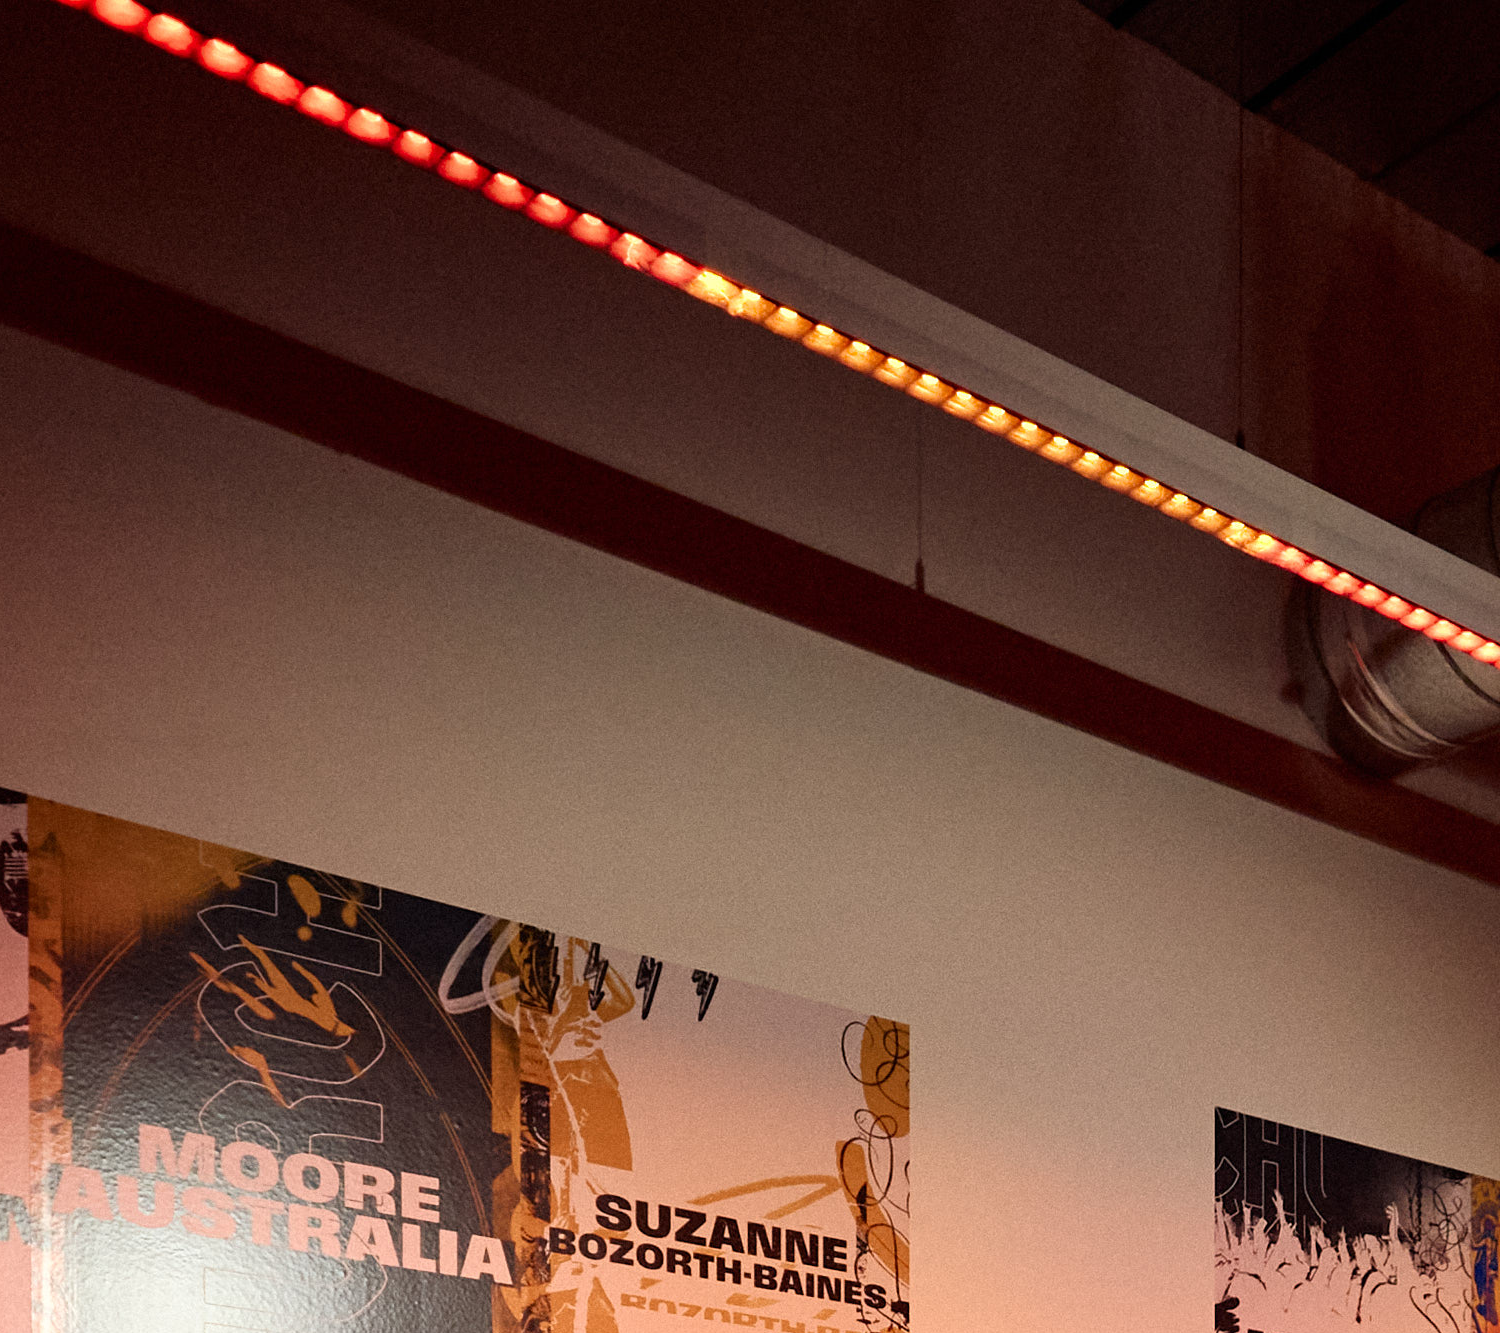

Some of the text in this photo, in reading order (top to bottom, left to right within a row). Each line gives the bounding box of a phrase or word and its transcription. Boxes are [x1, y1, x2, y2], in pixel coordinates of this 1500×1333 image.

[138, 1123, 440, 1225] MOORE
[52, 1162, 514, 1286] AUSTRALIA
[549, 1227, 886, 1309] BOZORTH-BAINES
[596, 1194, 847, 1272] SUZANNE
